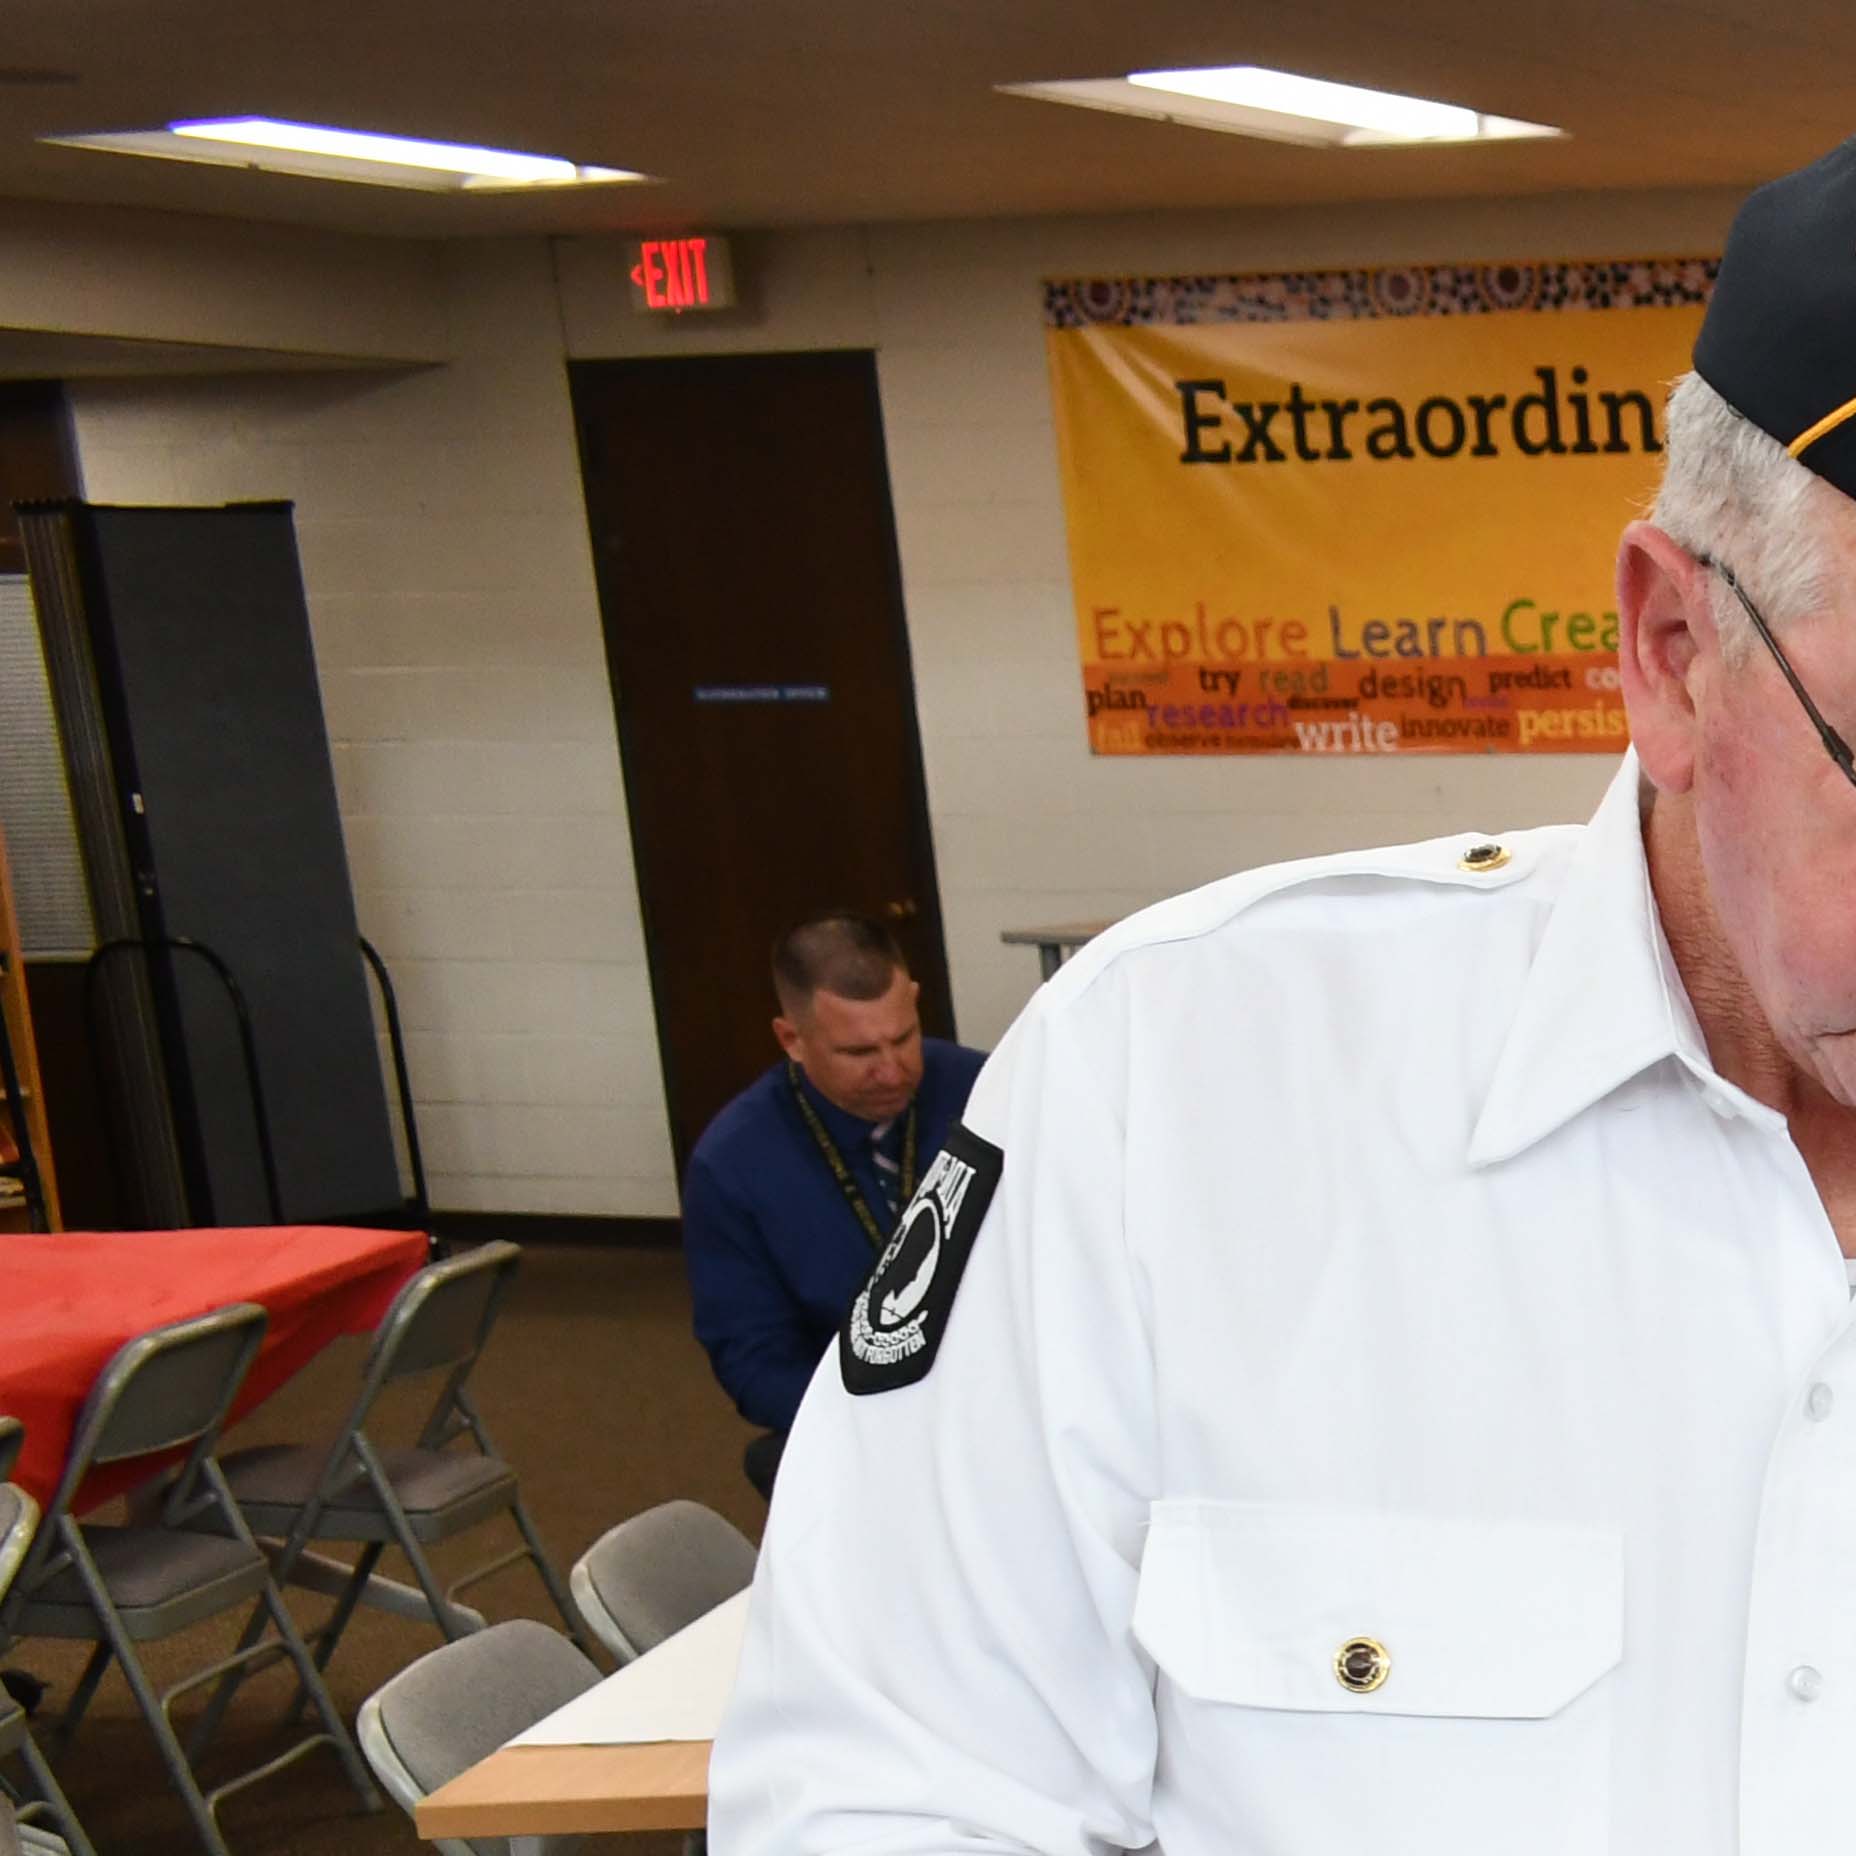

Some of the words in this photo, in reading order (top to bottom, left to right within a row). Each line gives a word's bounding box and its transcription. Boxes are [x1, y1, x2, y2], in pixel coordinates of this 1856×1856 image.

[642, 238, 708, 308] EXIT
[1176, 366, 1663, 463] Extraordin
[1094, 602, 1309, 676] Explore
[1329, 604, 1488, 660] Learn
[1501, 597, 1619, 656] Crea
[1199, 666, 1240, 696] try
[1260, 663, 1328, 693] read
[1359, 667, 1467, 708] design
[1489, 664, 1572, 693] predict
[1085, 683, 1146, 718] plan
[1147, 696, 1292, 728] research
[1295, 710, 1399, 752] write
[1400, 711, 1510, 739] innovate
[1518, 700, 1626, 747] persis
